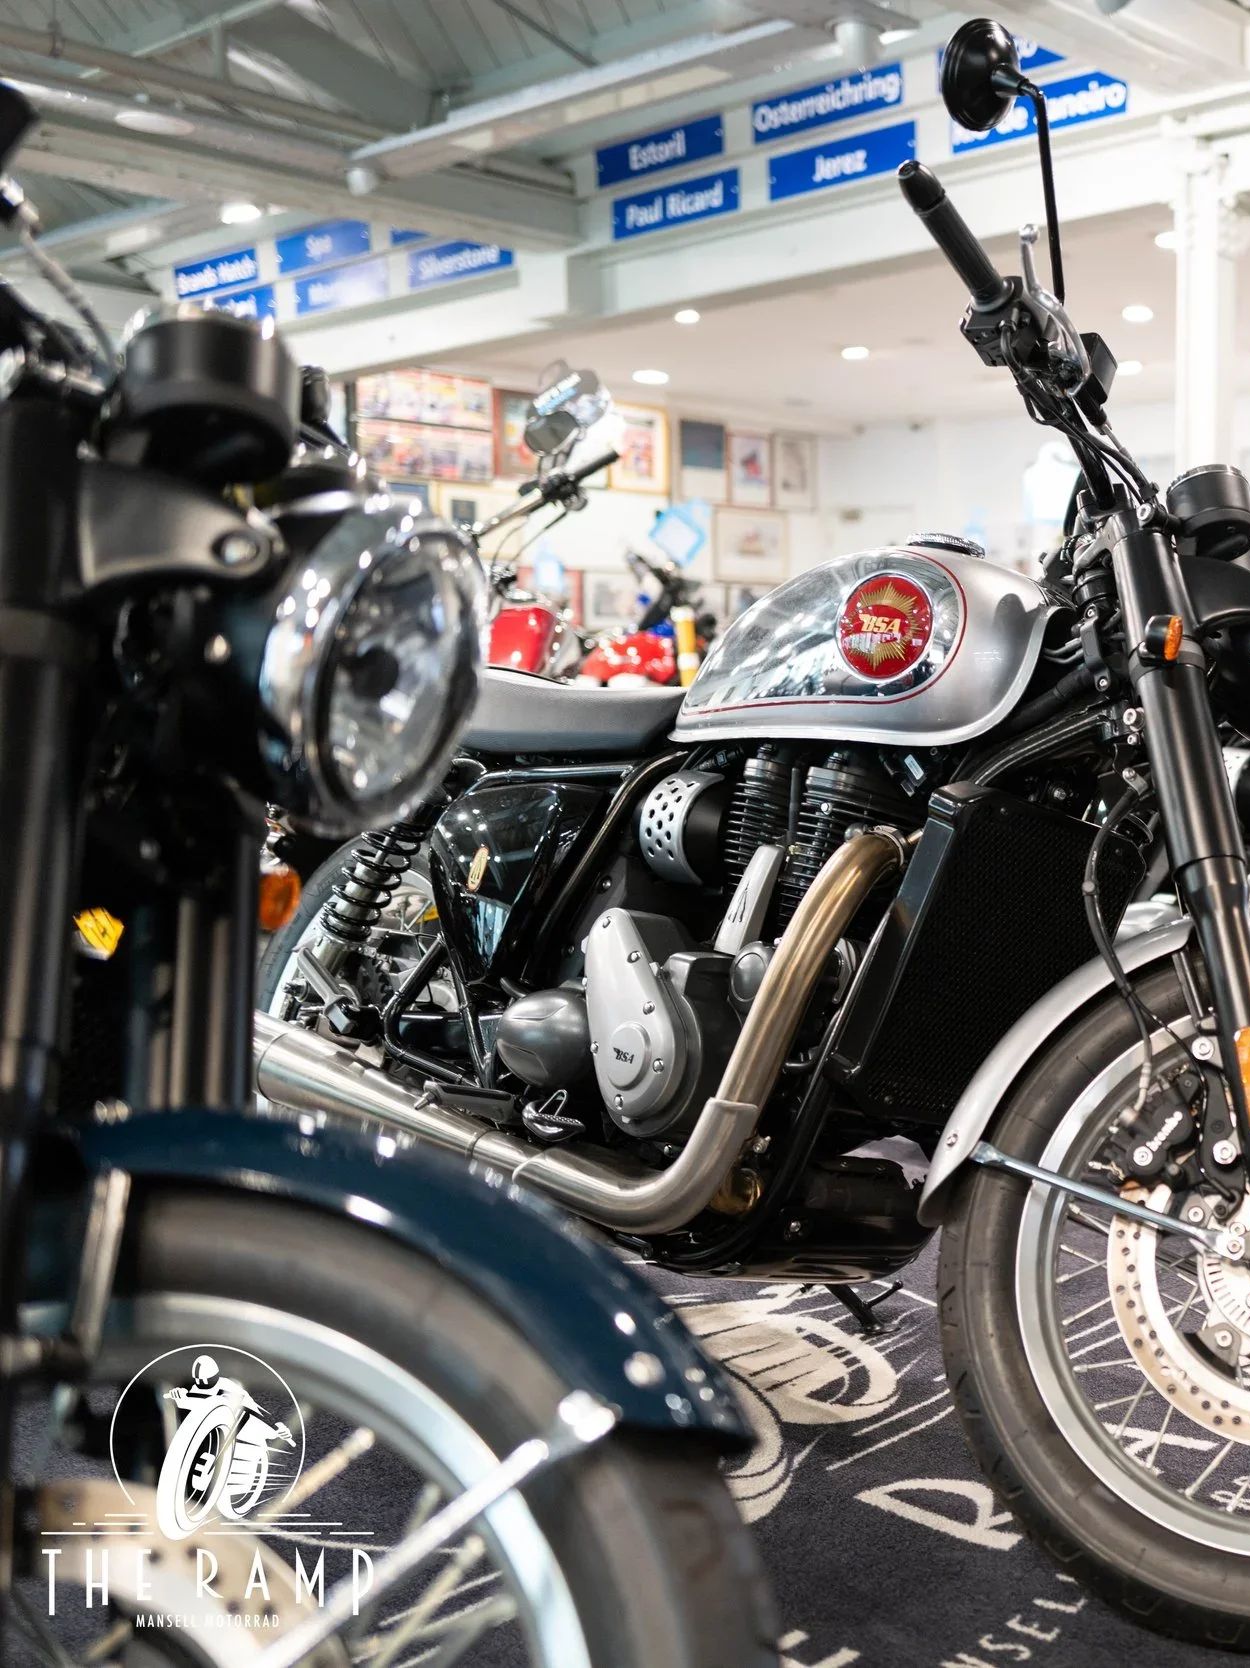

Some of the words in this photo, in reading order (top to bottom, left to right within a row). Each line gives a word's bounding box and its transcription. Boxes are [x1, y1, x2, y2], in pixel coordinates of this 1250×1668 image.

[1033, 80, 1127, 126] aneiro
[628, 128, 686, 171] Estoril
[812, 149, 867, 182] Jerez
[625, 196, 663, 230] Paul
[665, 179, 723, 219] Ricard
[859, 613, 901, 634] BSA
[612, 1046, 635, 1064] BSA
[1145, 1110, 1183, 1152] brembo
